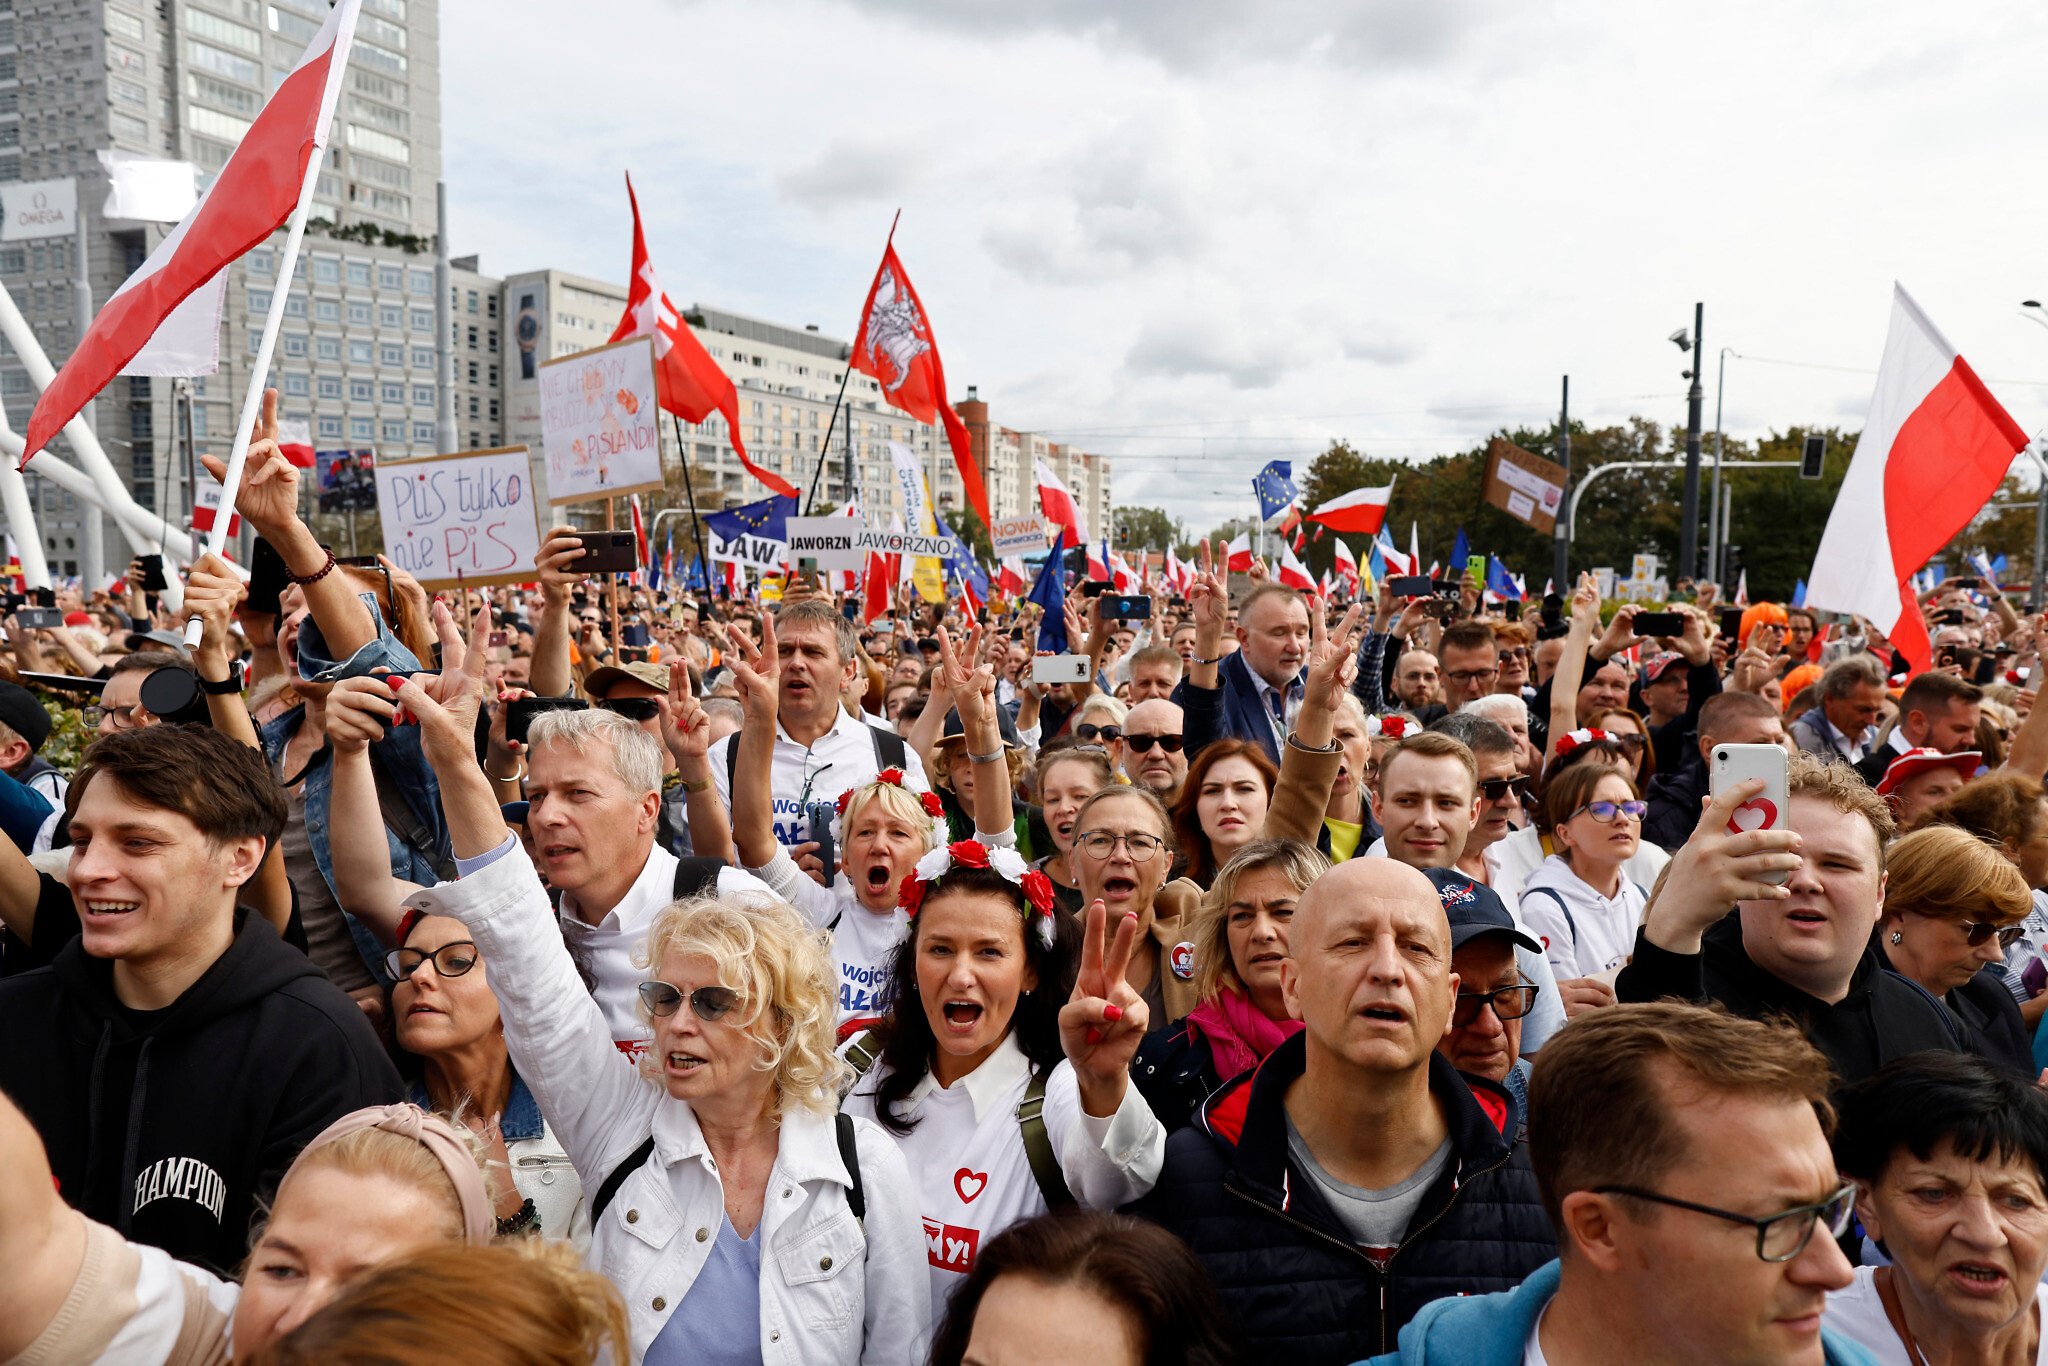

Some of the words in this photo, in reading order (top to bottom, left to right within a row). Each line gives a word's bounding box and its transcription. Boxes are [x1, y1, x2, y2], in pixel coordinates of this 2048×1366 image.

[19, 208, 65, 227] OMEGA
[542, 373, 563, 400] NIE
[454, 467, 521, 523] tylko
[993, 519, 1042, 538] NOWA
[995, 533, 1043, 547] Generacja
[394, 531, 434, 572] nie
[715, 536, 783, 566] JAW
[855, 532, 951, 555] JAWORZNO
[132, 1156, 227, 1227] HAMPION
